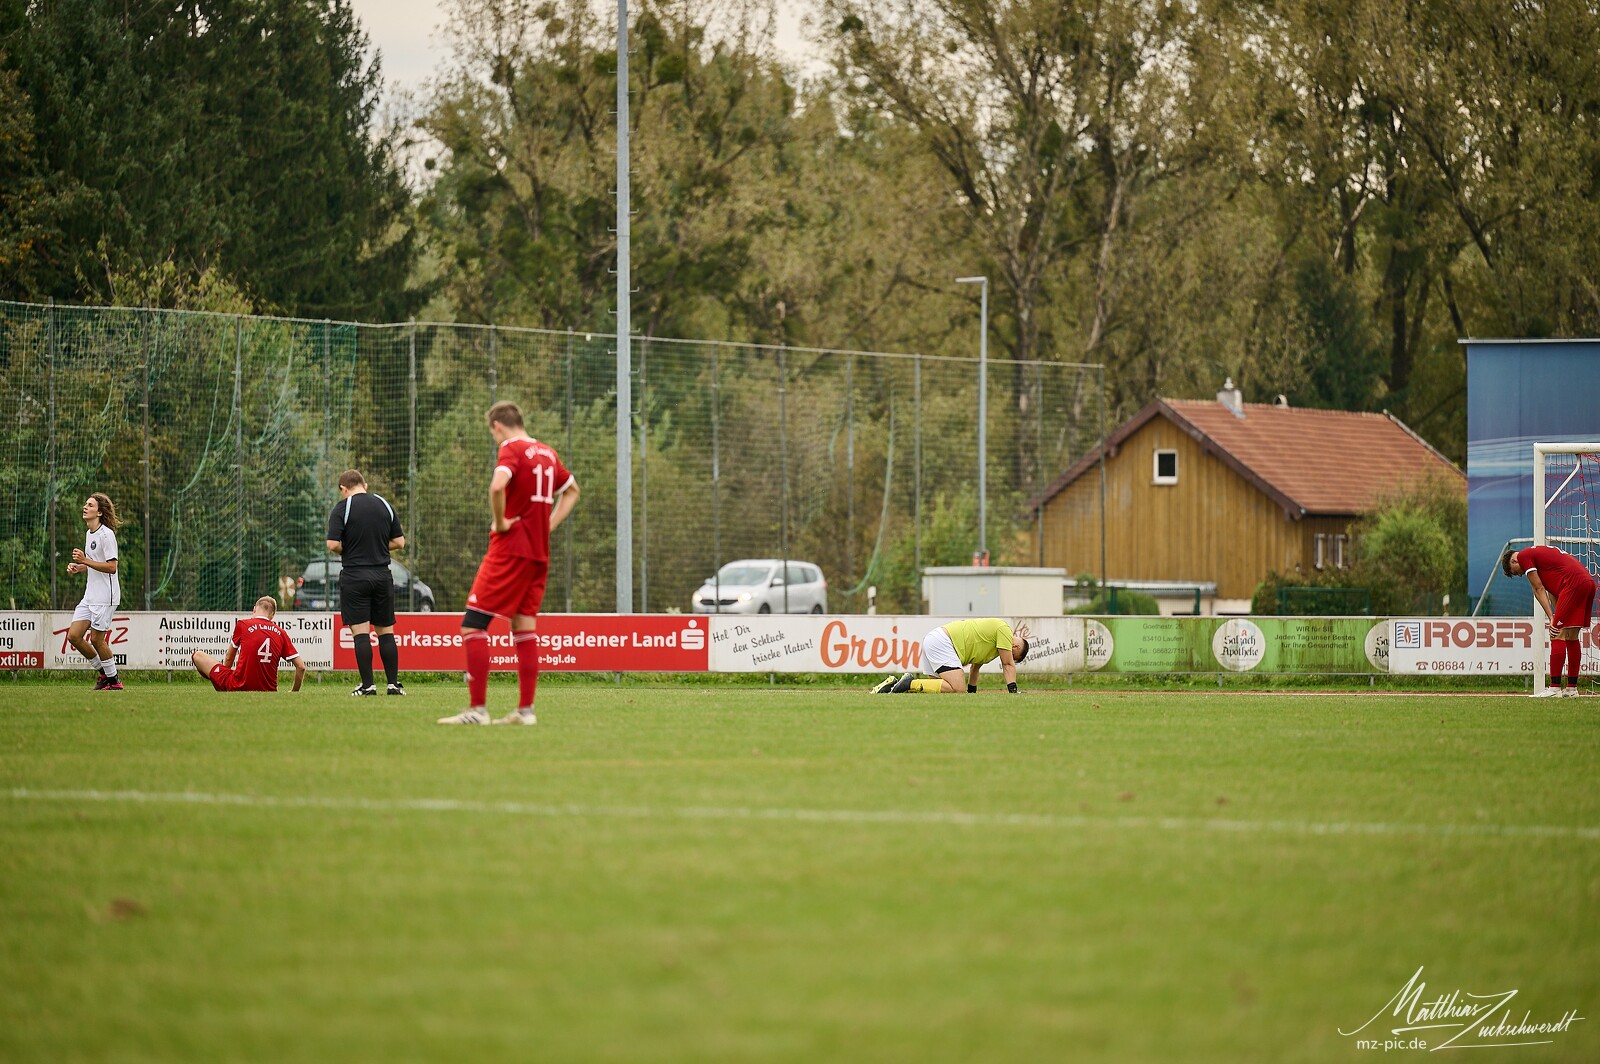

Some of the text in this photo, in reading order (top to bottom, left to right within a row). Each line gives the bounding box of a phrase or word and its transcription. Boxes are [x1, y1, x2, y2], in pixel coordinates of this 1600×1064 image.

[531, 463, 554, 504] 11
[159, 617, 231, 632] Ausbildung
[272, 617, 332, 631] ns-Textil
[248, 623, 281, 636] SV Laufen
[735, 625, 751, 637] Dir
[291, 636, 322, 645] orant/in
[370, 631, 463, 648] Sarkasse
[486, 631, 629, 651] erchesgadener
[632, 631, 677, 648] Land
[732, 631, 786, 654] den Schluck
[1224, 635, 1256, 647] Salzach
[257, 637, 273, 664] 4
[751, 638, 814, 666] frische Natur!
[1220, 646, 1259, 658] Apotheke
[54, 655, 65, 665] by
[489, 653, 577, 666] .sparke-bgl.de
[1432, 662, 1465, 671] 08684
